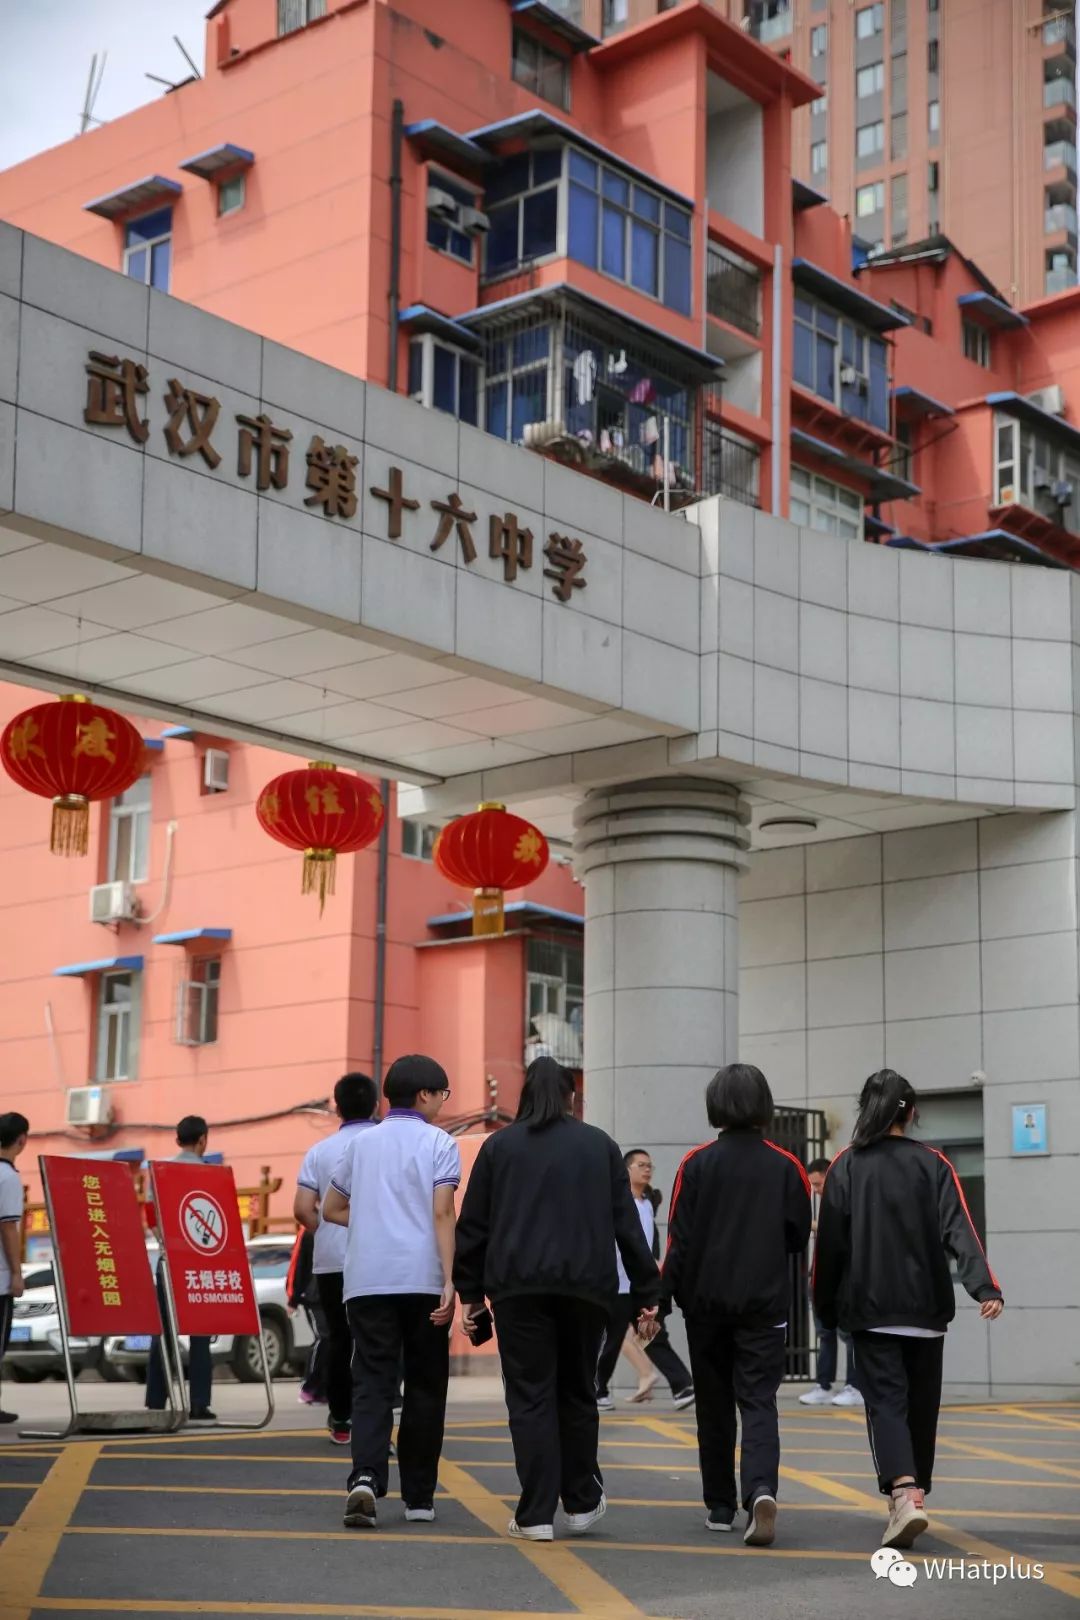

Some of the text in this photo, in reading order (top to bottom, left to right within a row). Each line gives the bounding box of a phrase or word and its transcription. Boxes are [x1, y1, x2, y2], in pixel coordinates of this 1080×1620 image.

[83, 350, 588, 602] 武汉市第十六中学
[82, 1174, 122, 1306] 您已进入无烟校园
[184, 1269, 243, 1291] 无烟学校
[188, 1292, 245, 1304] NO SMOKING
